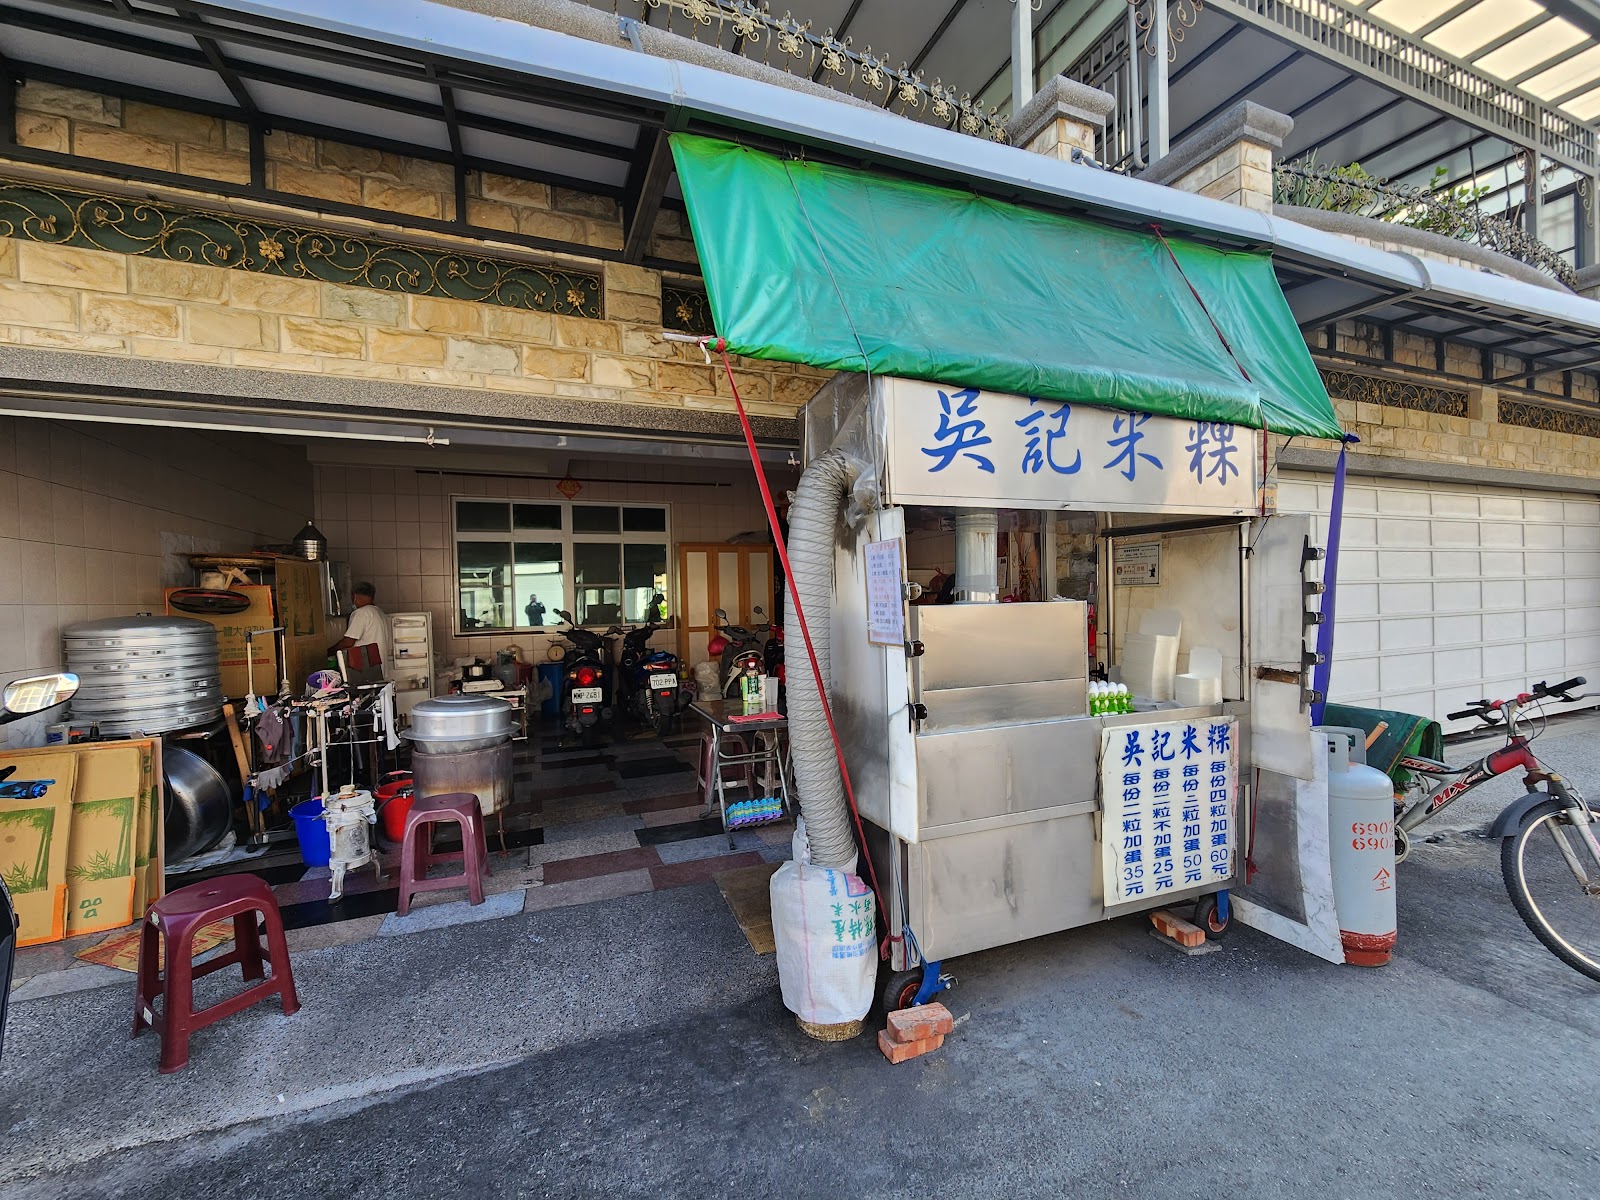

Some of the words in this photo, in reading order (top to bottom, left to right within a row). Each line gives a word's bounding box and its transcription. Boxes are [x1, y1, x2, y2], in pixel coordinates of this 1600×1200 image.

[921, 388, 1238, 486] 吳記米粿
[1121, 723, 1230, 767] 吳記米粿
[1432, 774, 1471, 810] MX
[1372, 867, 1391, 892] 全
